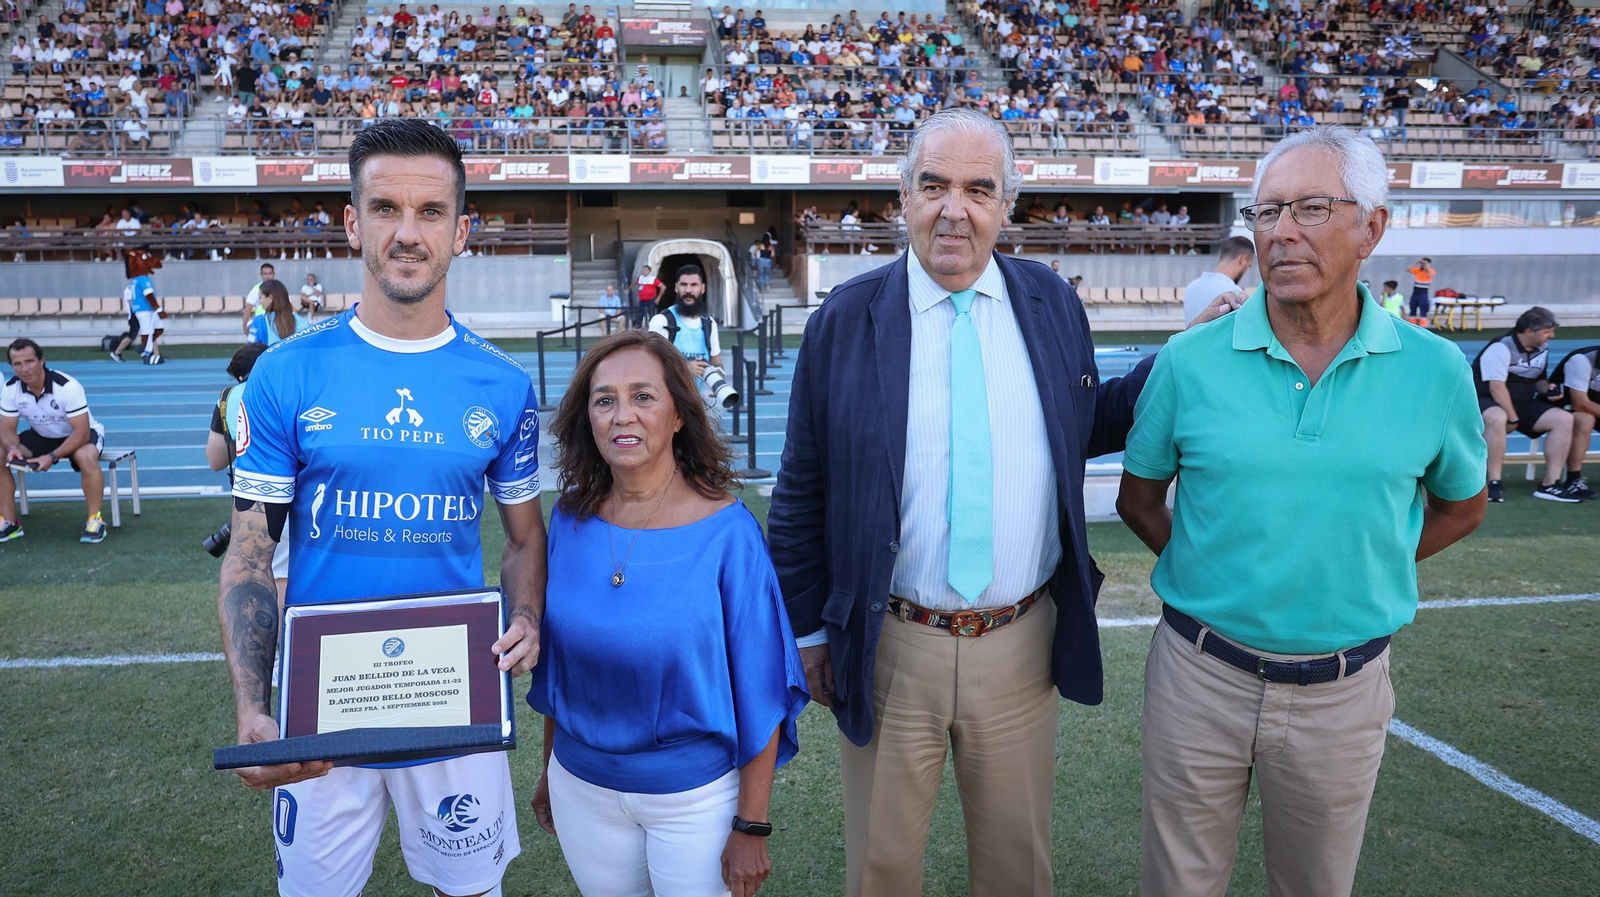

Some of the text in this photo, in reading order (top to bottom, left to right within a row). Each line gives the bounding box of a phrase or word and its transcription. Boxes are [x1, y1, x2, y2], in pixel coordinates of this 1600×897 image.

[71, 163, 173, 183] PLAY JEREZ
[264, 163, 350, 181] PLAY JERE
[465, 162, 550, 180] LAY JEREZ
[637, 162, 732, 180] PLAY JEREZ
[816, 163, 900, 180] PLAY JERE
[1023, 163, 1077, 181] JEREZ
[1155, 165, 1240, 183] PLAY JEREZ
[1467, 169, 1547, 185] PLAY JEREZ
[304, 423, 333, 432] umbro
[360, 427, 445, 445] TIO PEPE
[334, 489, 478, 521] HIPOTELS
[333, 524, 453, 544] Hotels & Resorts
[383, 659, 414, 667] TROFEO
[332, 666, 456, 683] JUAN BELLIDO DE LA VEGA
[326, 686, 354, 694] MEJOR
[356, 683, 392, 692] JUGADOR
[393, 679, 441, 689] TEMPORADA
[329, 689, 460, 706] D.ANTONIO BELLO MOSCOSO
[340, 706, 363, 714] JEREZ
[386, 701, 431, 709] SEPTIEMBRE
